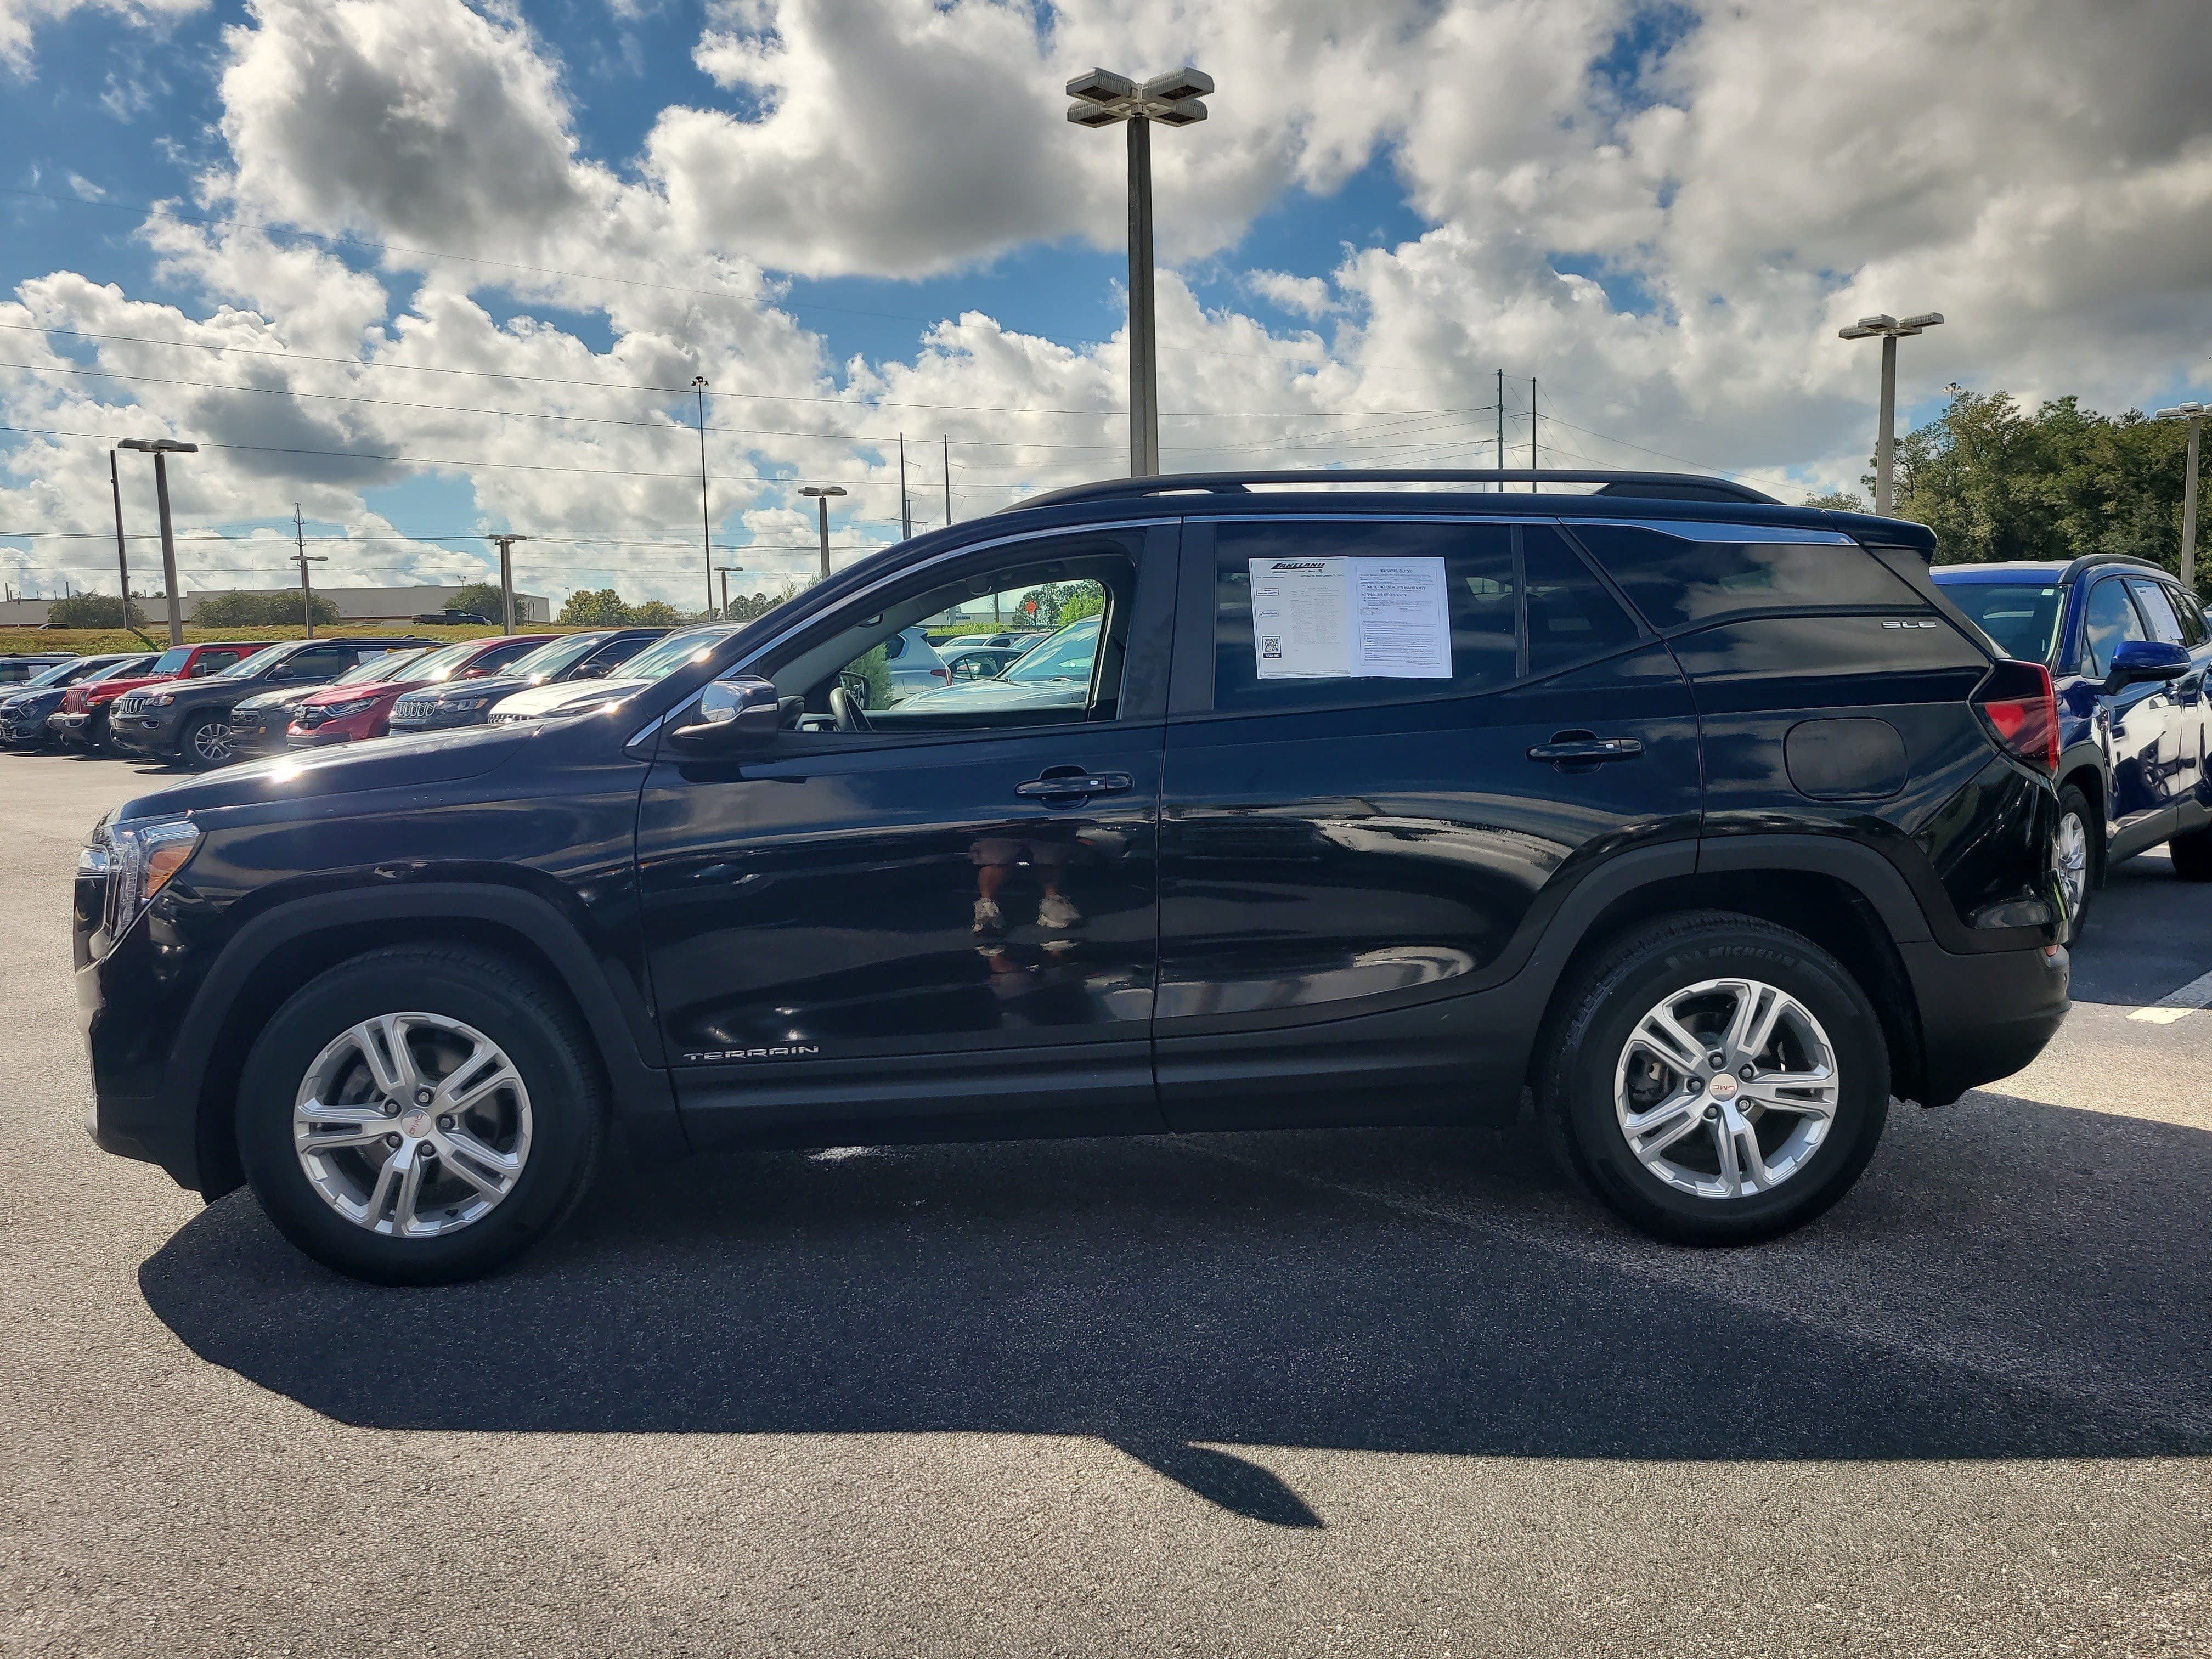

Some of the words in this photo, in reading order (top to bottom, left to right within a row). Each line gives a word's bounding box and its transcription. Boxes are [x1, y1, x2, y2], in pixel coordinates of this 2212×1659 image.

[1708, 946, 1795, 967] MICHELIN
[683, 1046, 819, 1060] TERRAIN
[409, 1114, 424, 1135] GMC
